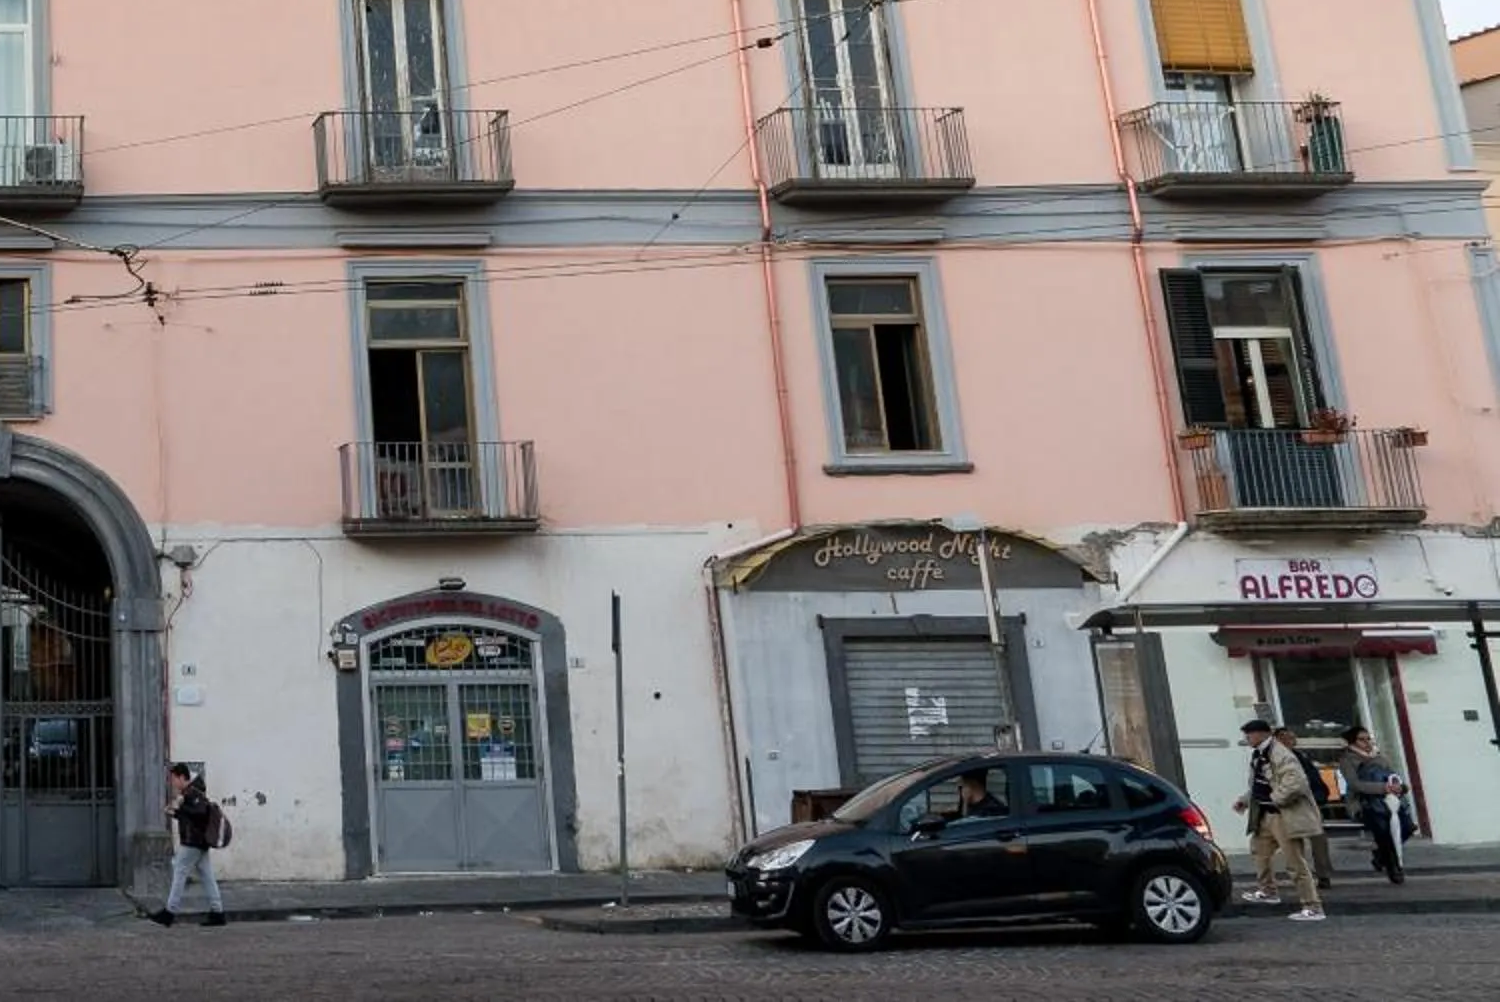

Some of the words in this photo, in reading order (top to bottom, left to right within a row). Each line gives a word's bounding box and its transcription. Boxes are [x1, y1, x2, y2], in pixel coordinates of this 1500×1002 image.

[813, 534, 932, 566] Hollywood
[1289, 560, 1321, 572] BAR
[1240, 575, 1378, 599] ALFREDO
